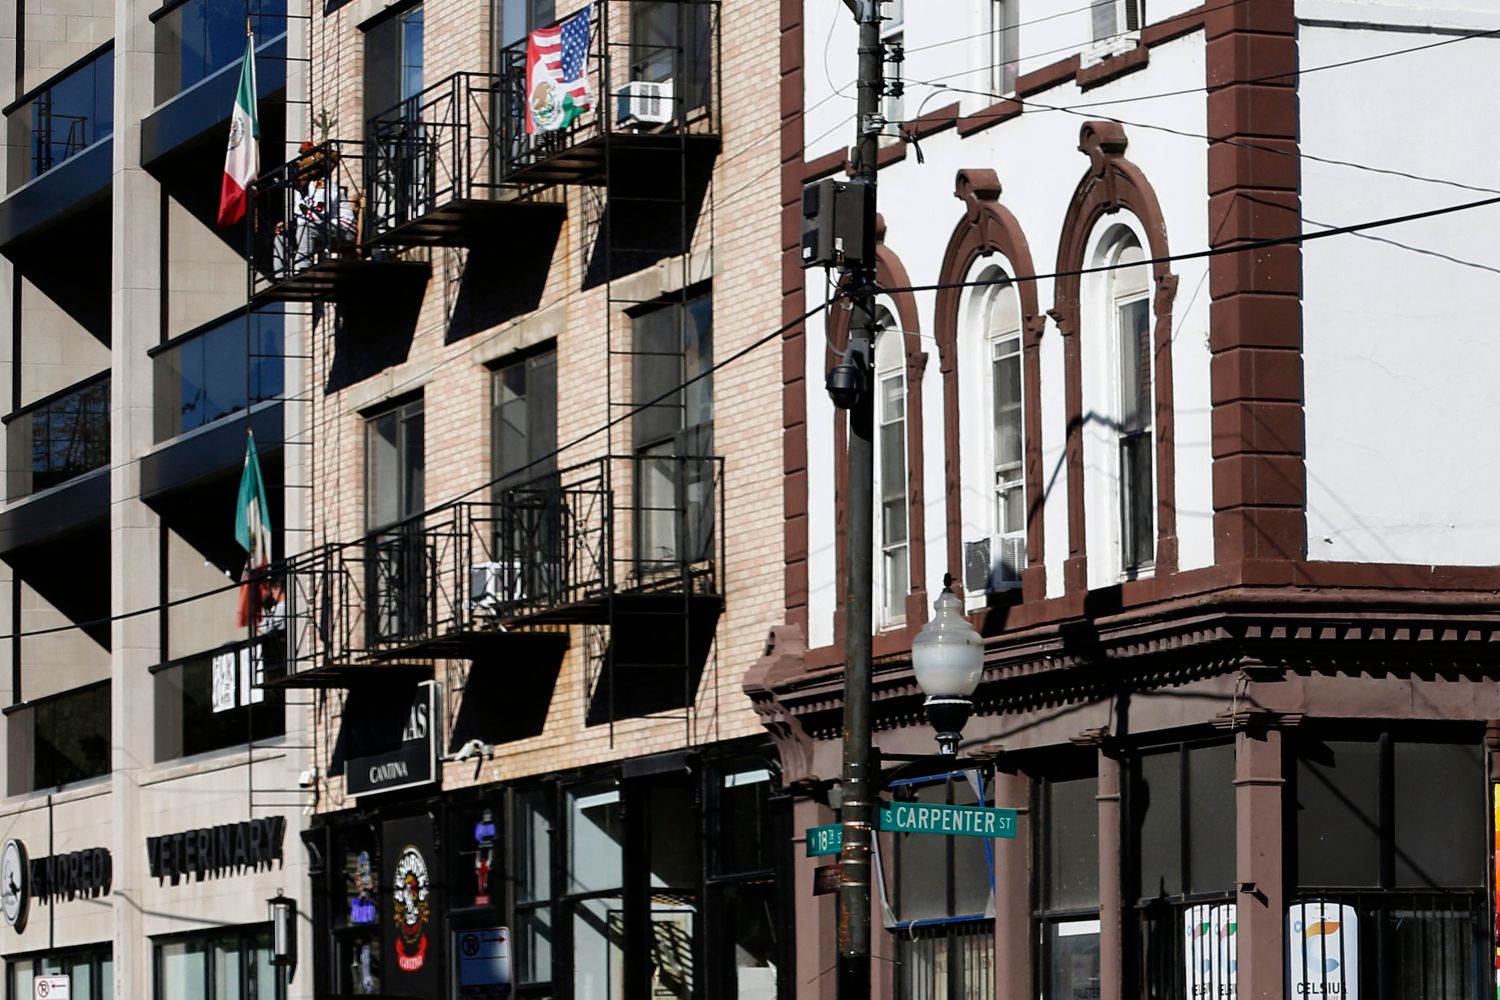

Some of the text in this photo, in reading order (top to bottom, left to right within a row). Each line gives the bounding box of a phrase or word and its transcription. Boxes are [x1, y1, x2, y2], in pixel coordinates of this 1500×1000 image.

[885, 806, 1012, 833] S CARPENTER ST
[30, 818, 284, 899] KNDRED VETERINARY
